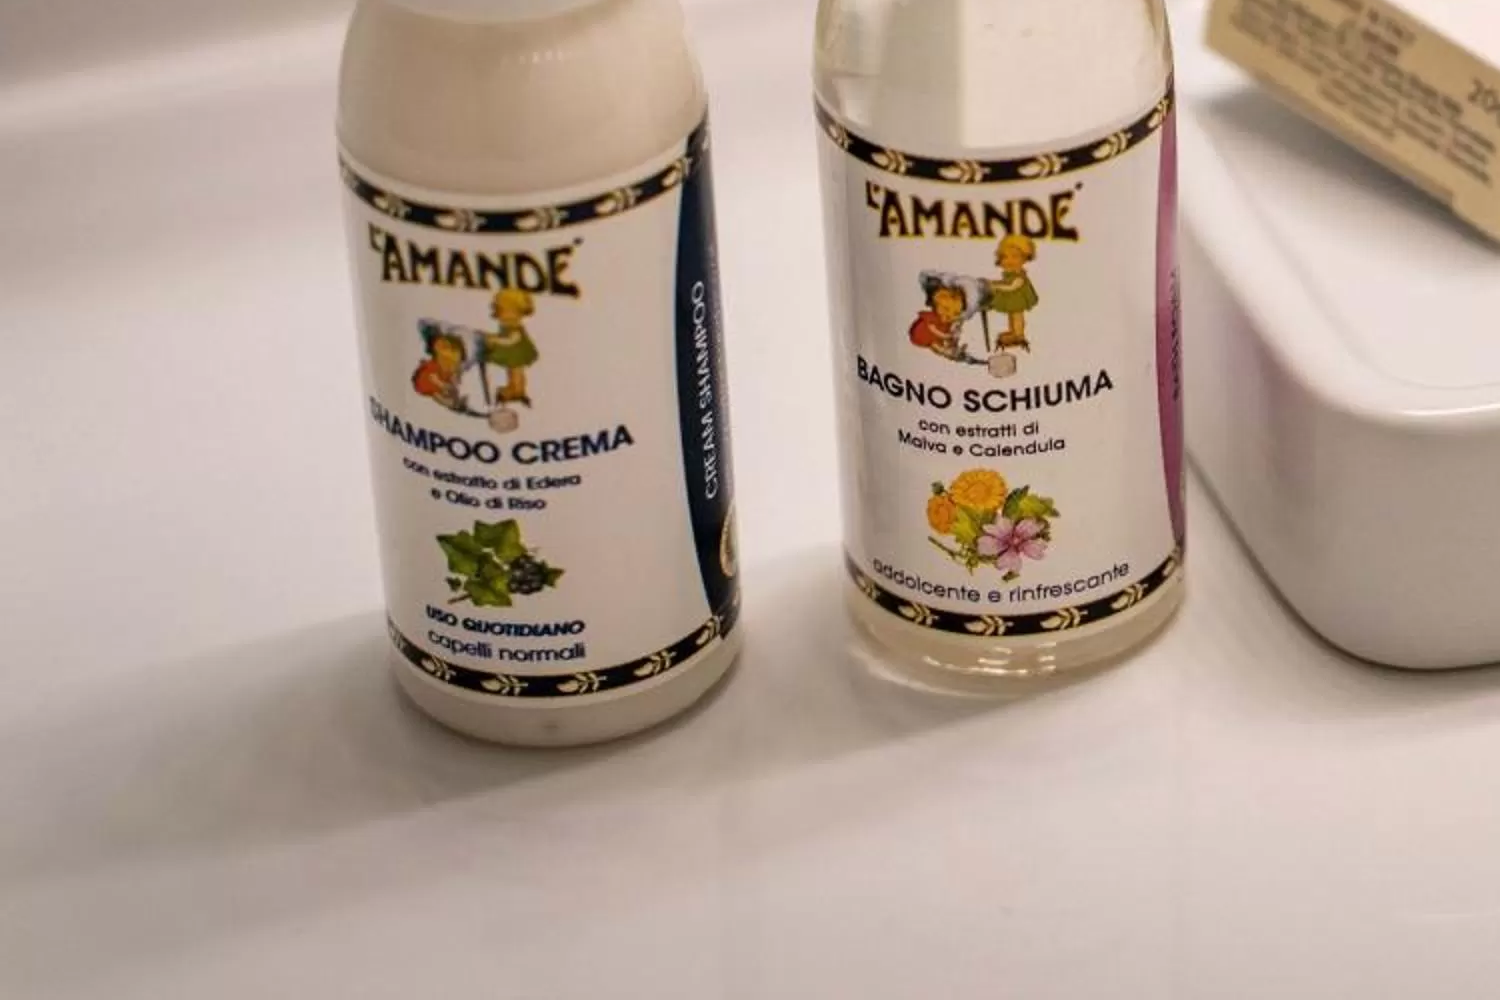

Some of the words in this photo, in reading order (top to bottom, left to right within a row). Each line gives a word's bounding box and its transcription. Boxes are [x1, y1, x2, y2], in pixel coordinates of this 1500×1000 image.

[691, 281, 713, 409] SHAMPOO
[857, 354, 952, 409] BAGNO
[963, 369, 1114, 413] SCHIUMA
[512, 424, 634, 464] CREMA
[898, 429, 947, 454] Malva
[953, 444, 963, 456] e
[969, 437, 1065, 458] Calendula
[918, 418, 950, 435] con
[956, 422, 1017, 439] estratti
[1023, 420, 1039, 436] di
[701, 410, 718, 499] CREAM
[403, 457, 430, 476] con
[503, 476, 521, 490] di
[527, 475, 581, 491] Edera
[431, 488, 441, 500] e
[485, 497, 502, 509] di
[873, 559, 981, 603] addolcente
[988, 589, 1001, 603] e
[1009, 560, 1129, 603] rinfrescante
[426, 604, 457, 627] USO
[462, 617, 586, 637] QUOTIDIANO
[427, 630, 492, 659] capelli
[499, 641, 586, 661] normali
